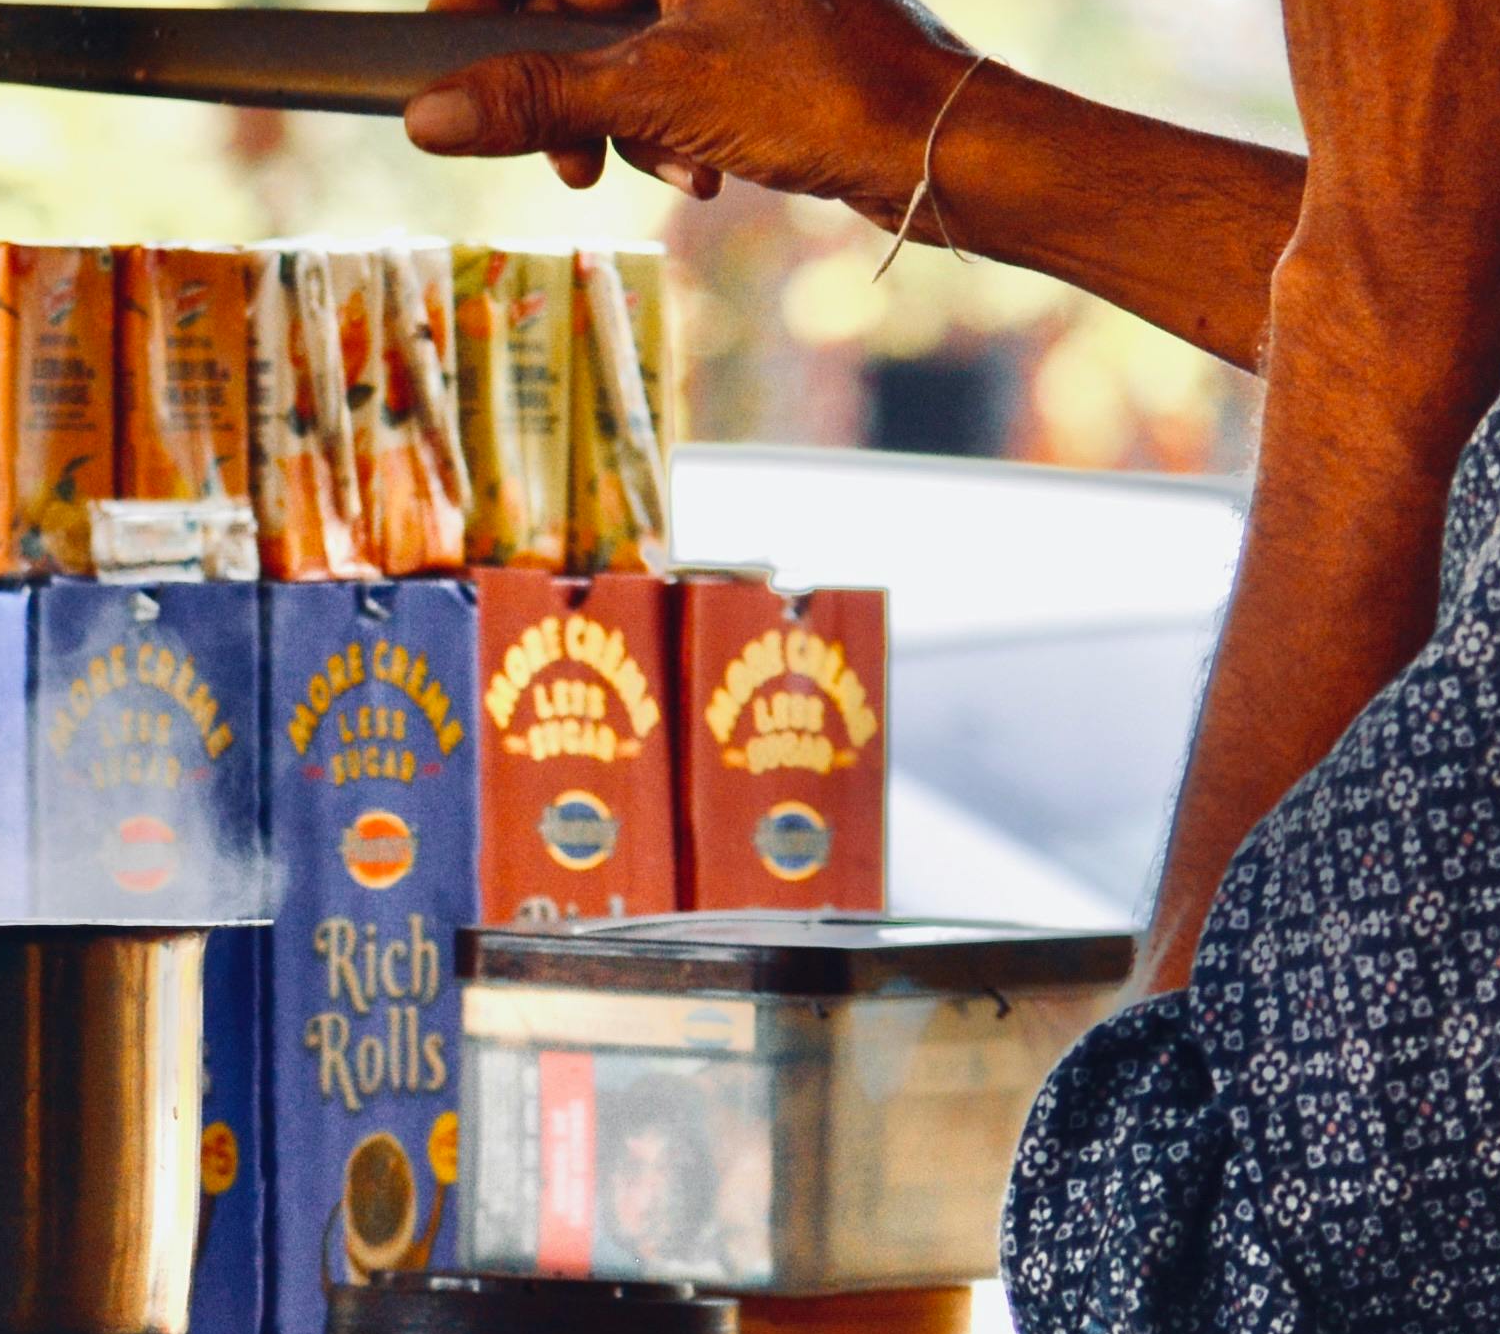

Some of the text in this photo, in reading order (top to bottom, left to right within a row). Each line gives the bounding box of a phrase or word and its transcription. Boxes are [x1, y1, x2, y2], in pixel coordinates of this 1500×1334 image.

[286, 641, 366, 756] MORE
[337, 706, 407, 743] LESS
[483, 616, 564, 730] MORE
[531, 678, 608, 721] LESS
[703, 629, 783, 745] MORE
[330, 749, 417, 788] SUGAR
[313, 913, 442, 1015] Rich
[303, 1004, 450, 1113] Rolls
